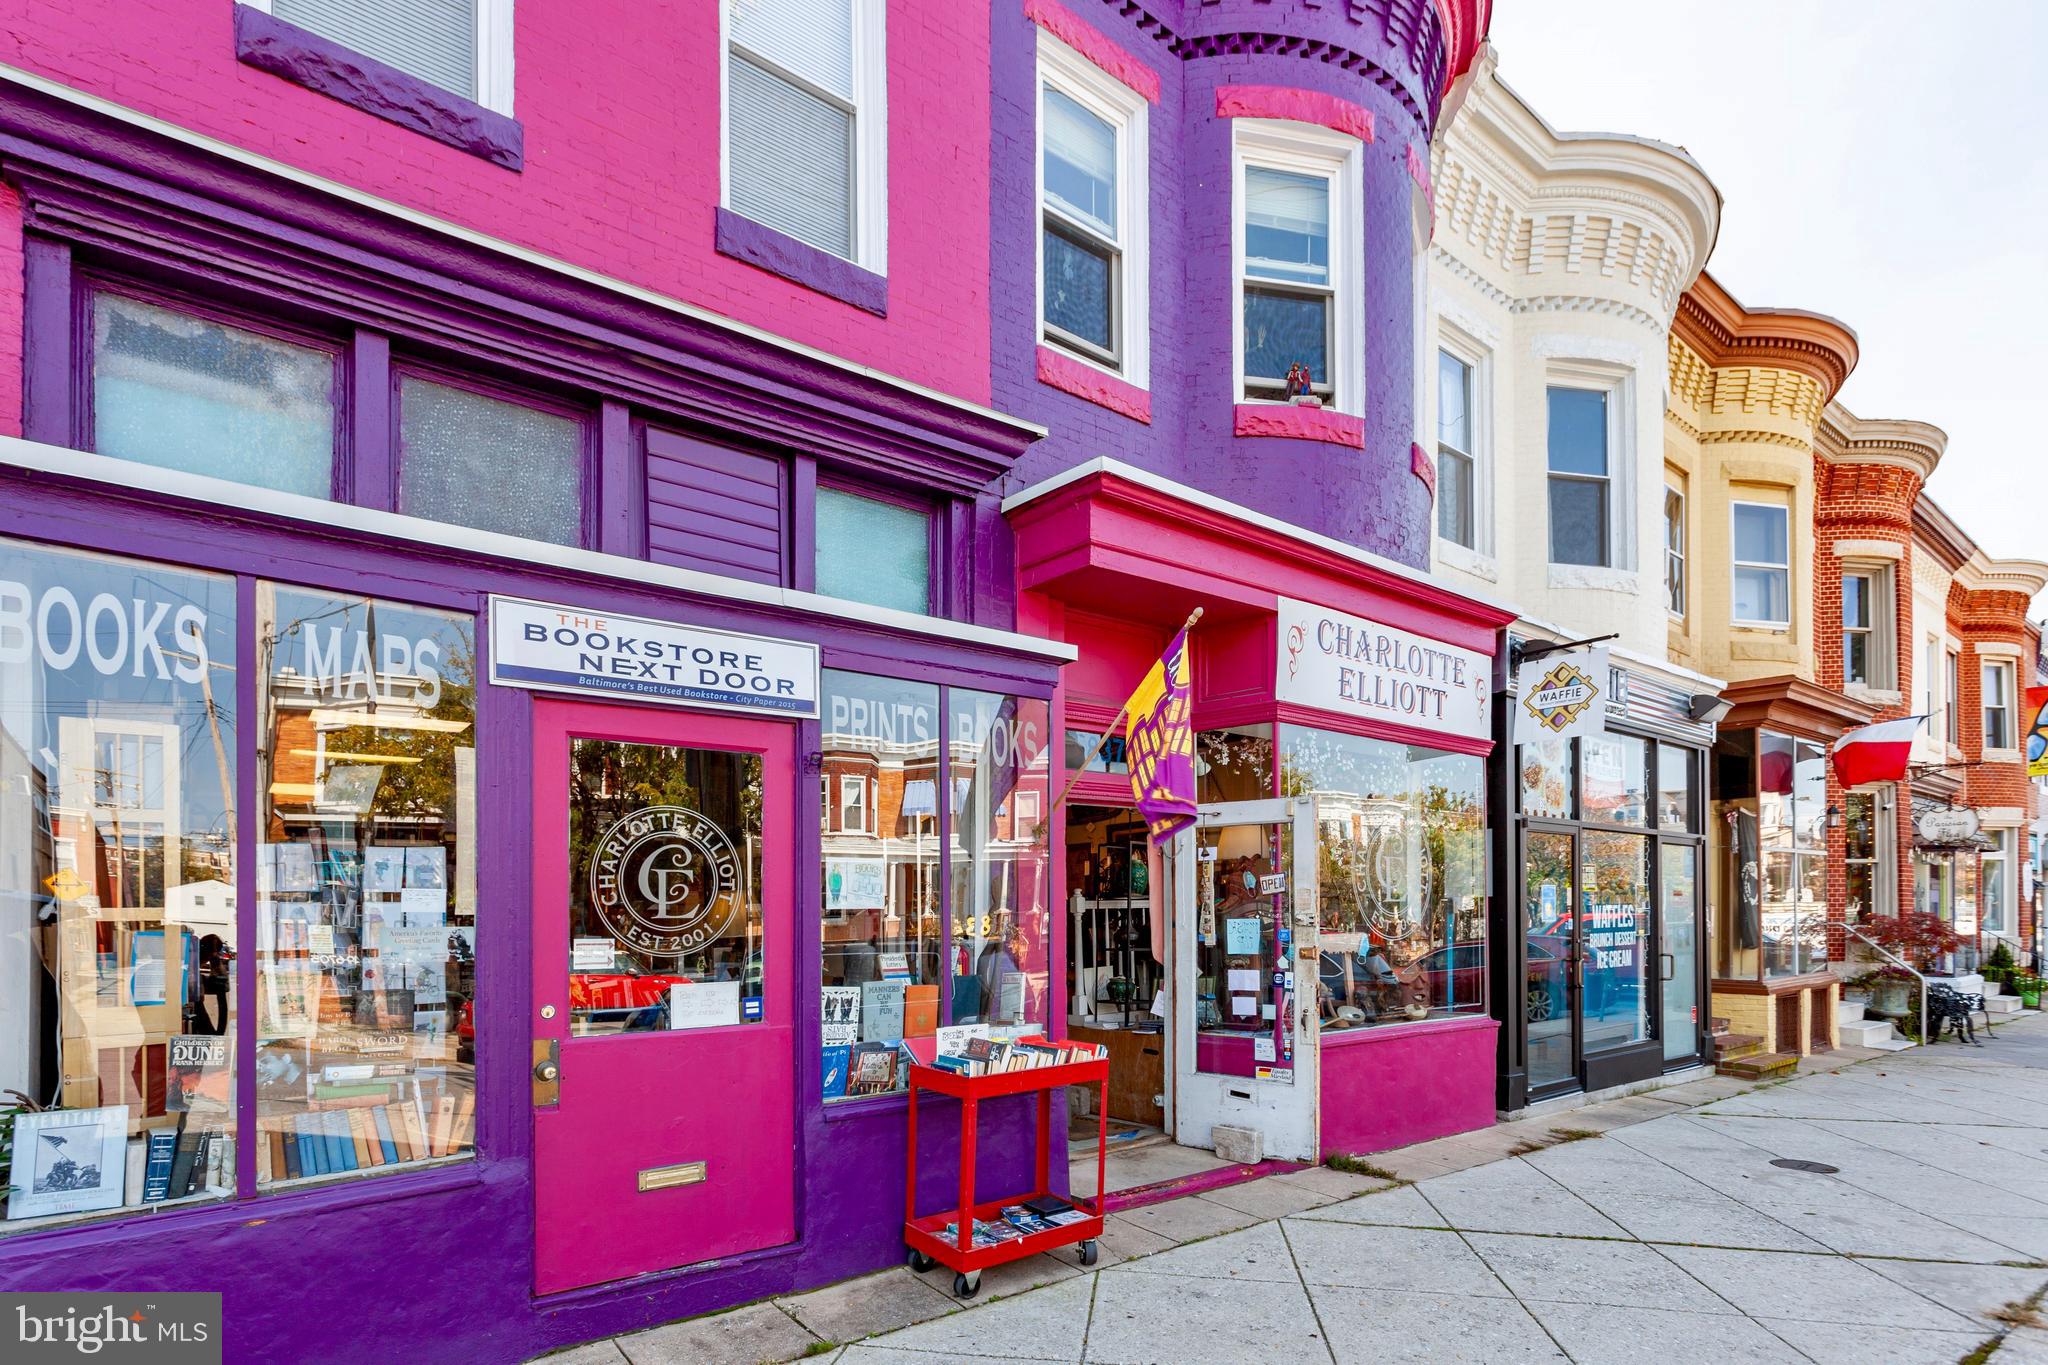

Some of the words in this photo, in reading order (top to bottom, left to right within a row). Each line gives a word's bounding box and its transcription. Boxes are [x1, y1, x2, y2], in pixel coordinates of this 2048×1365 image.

[0, 579, 208, 684] BOOKS
[556, 613, 608, 632] THE
[524, 622, 763, 672] BOOKSTORE
[1317, 618, 1467, 688] CHARLOTTE
[303, 622, 442, 710] MAPS
[579, 653, 682, 681] NEXT
[699, 668, 796, 696] DOOR
[579, 676, 635, 690] Baltimore's
[637, 683, 658, 693] Best
[660, 685, 683, 696] Used
[684, 688, 728, 701] Bookstore
[735, 694, 752, 706] City
[754, 697, 776, 708] Paper
[778, 700, 796, 710] 2015
[1337, 666, 1448, 720] ELLIOTT
[1539, 687, 1582, 702] WAFFIE
[831, 694, 929, 758] PRINTS
[958, 712, 1039, 771] BOOKS
[598, 813, 686, 907] CHARLOTTE
[692, 821, 736, 906] ELLIOTT
[1261, 877, 1285, 892] OPEN
[1592, 904, 1634, 928] WAFFLES
[626, 925, 664, 950] EST
[671, 922, 714, 950] 2001
[1589, 932, 1613, 948] BRUNCH
[1615, 931, 1637, 947] DESSERT
[1597, 951, 1608, 969] ICE
[1609, 949, 1633, 968] CREAM
[868, 985, 900, 994] MANNERS
[880, 1007, 893, 1016] FUN
[172, 1046, 225, 1061] DUNE
[356, 1035, 408, 1047] SWORD
